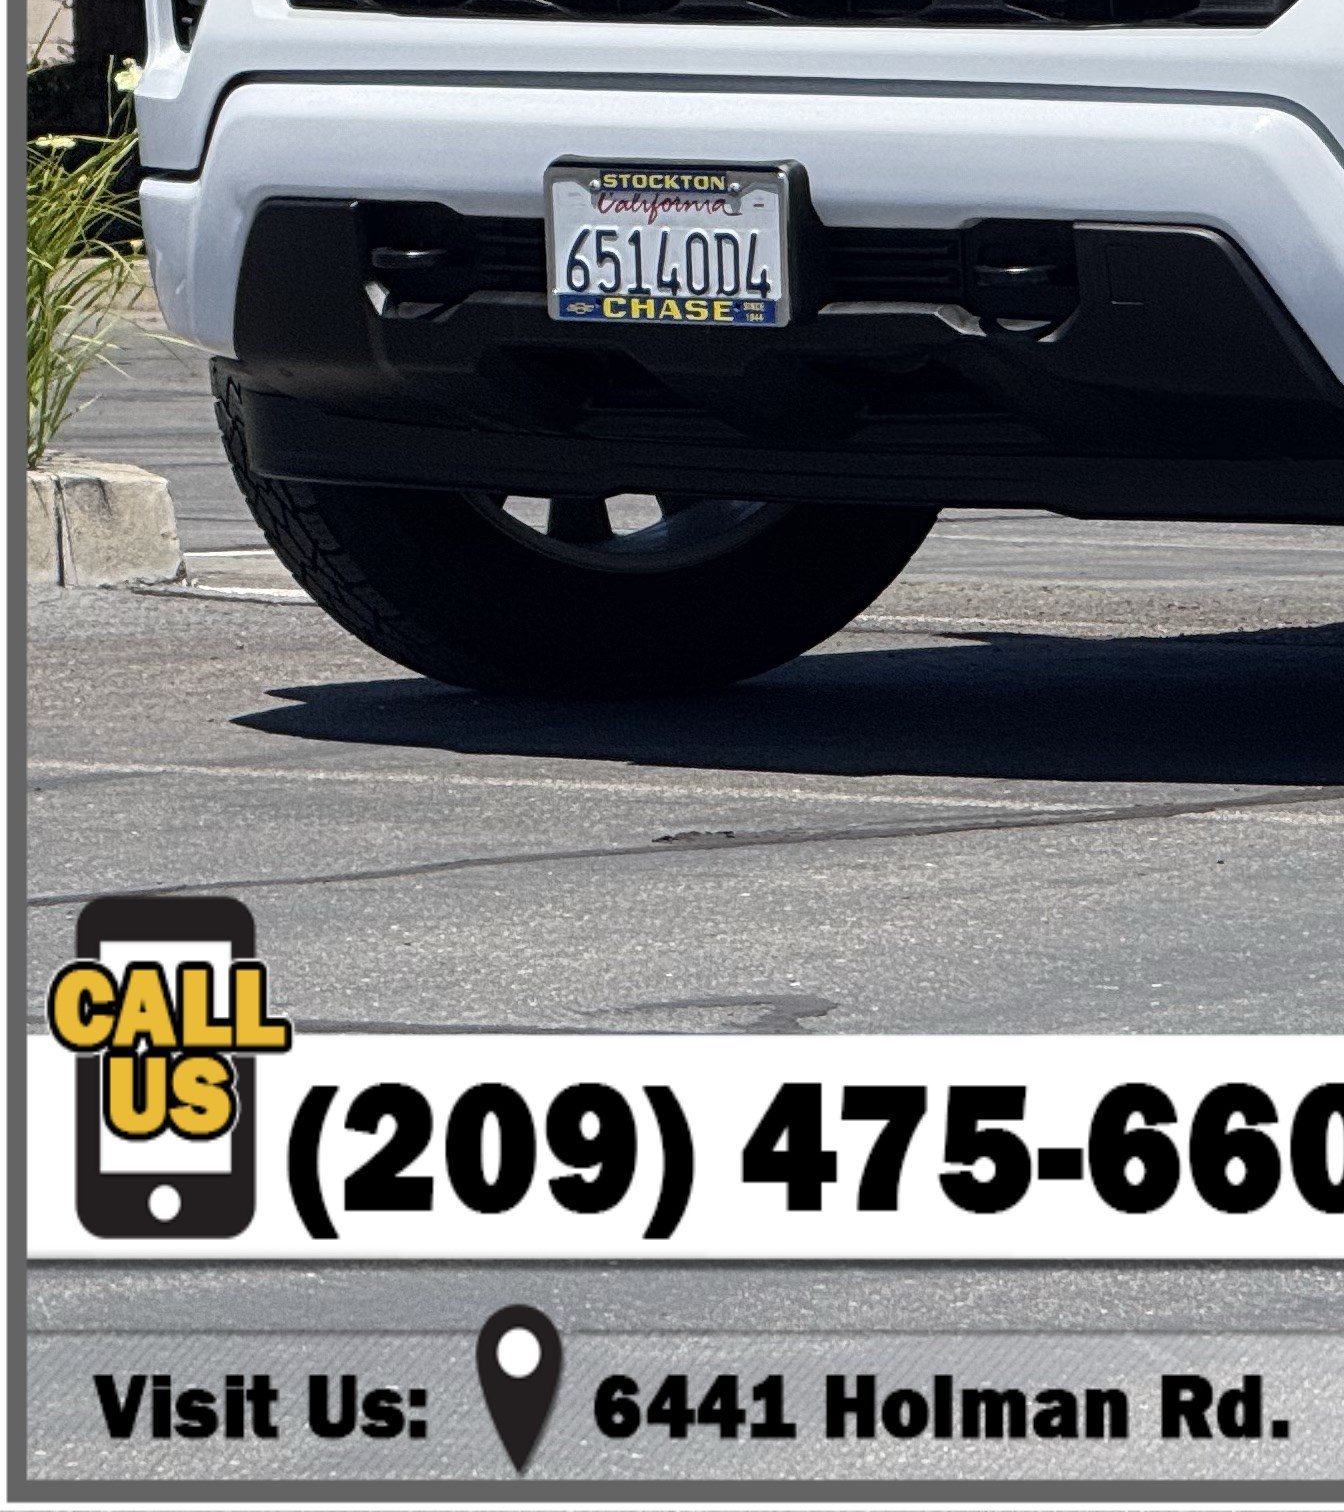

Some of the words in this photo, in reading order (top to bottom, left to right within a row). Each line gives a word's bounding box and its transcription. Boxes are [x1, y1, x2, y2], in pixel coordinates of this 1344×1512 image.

[602, 174, 725, 190] STOCKTON
[597, 191, 742, 225] California
[566, 228, 771, 297] 65140D4
[602, 297, 735, 321] CHASE
